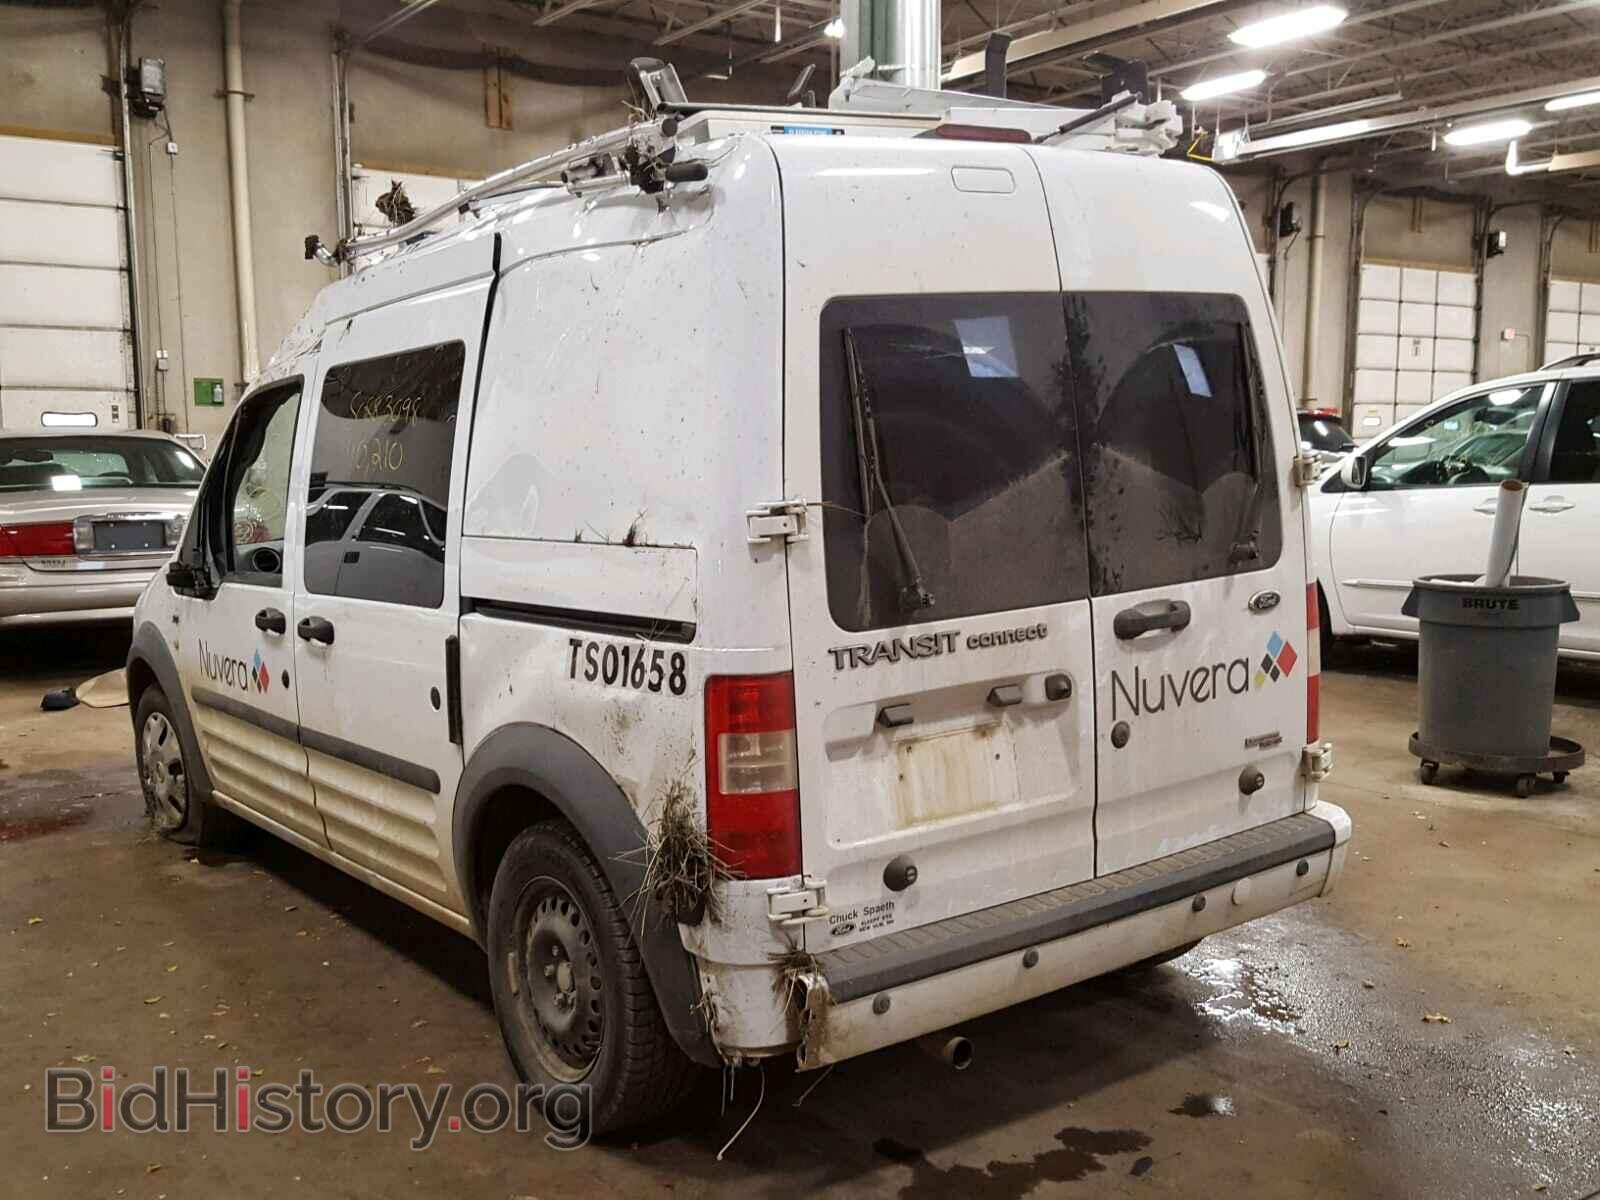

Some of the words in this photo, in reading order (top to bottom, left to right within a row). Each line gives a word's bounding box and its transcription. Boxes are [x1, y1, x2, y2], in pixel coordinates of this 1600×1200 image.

[1462, 598, 1520, 611] BRUTE
[198, 638, 249, 692] Nuvera
[569, 638, 687, 695] TS01658
[828, 631, 961, 671] TRANSIT
[967, 623, 1048, 650] connect
[1111, 657, 1250, 722] Nuvera
[829, 909, 858, 924] Chuck
[863, 901, 895, 916] Spaeth
